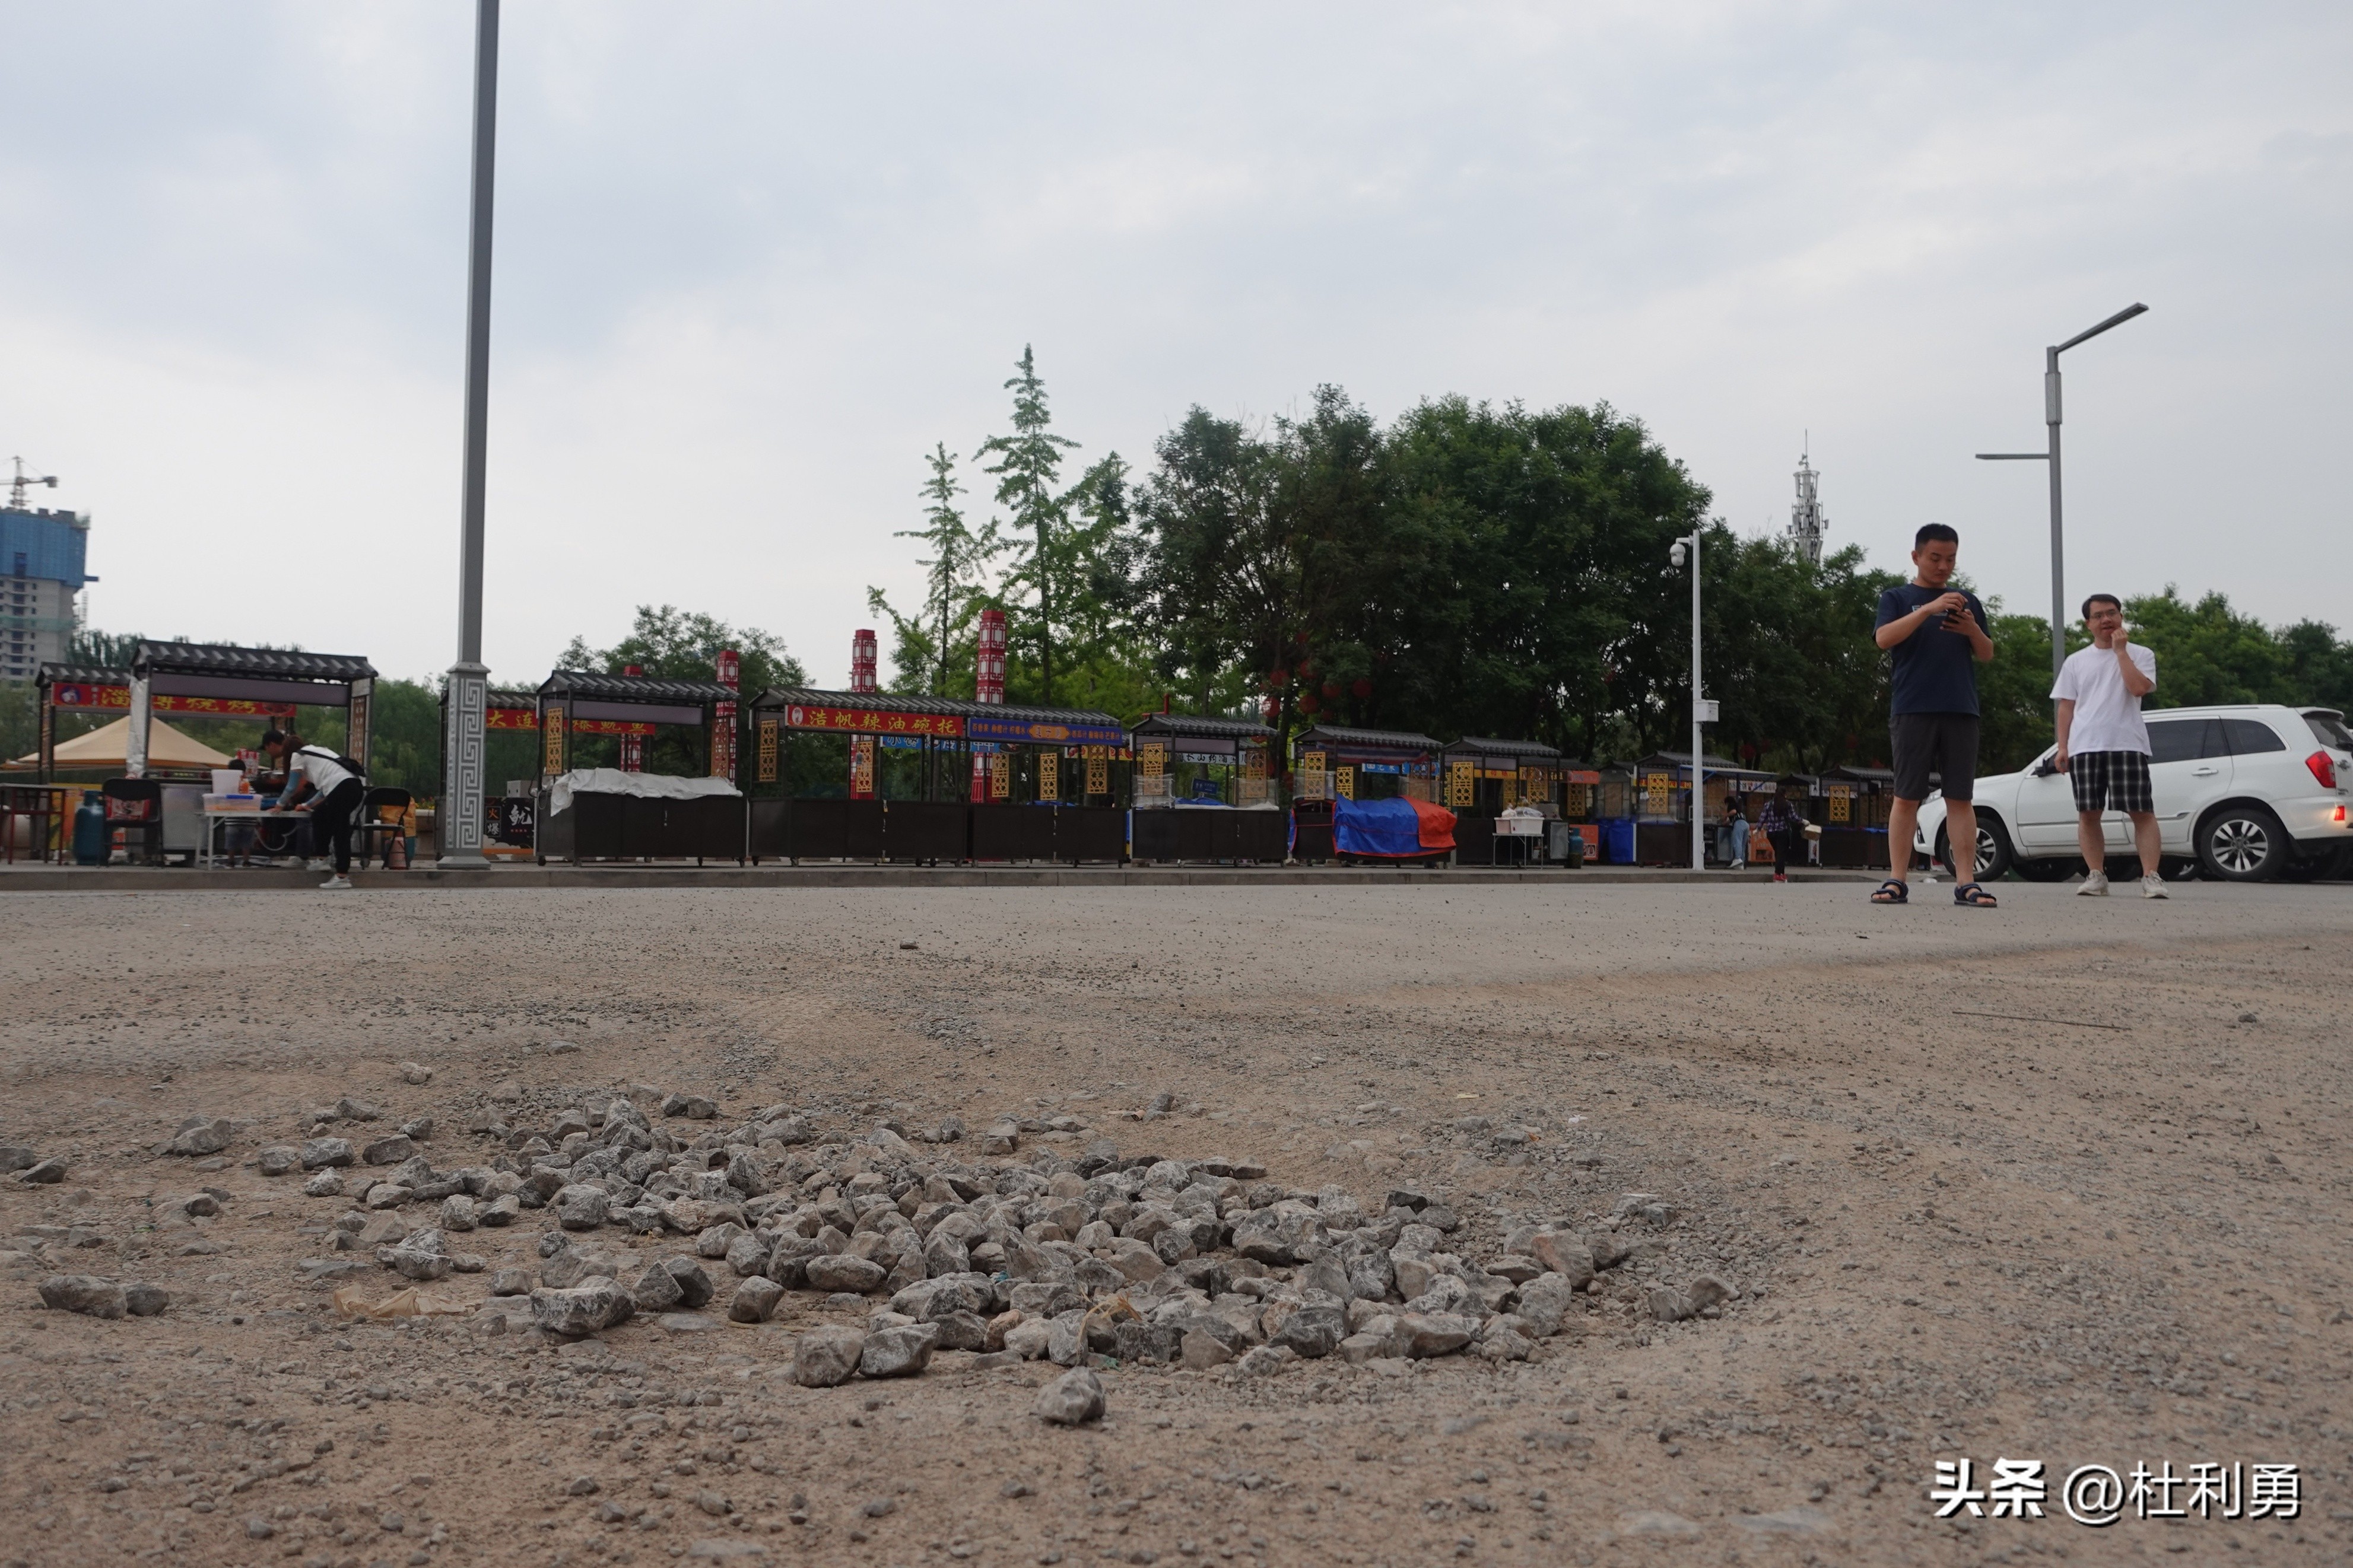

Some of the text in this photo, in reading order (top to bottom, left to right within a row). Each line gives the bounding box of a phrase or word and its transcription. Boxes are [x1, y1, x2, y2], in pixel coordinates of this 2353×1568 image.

[488, 710, 646, 731] 大连爆鱿鱼
[809, 709, 957, 733] 浩帆辣油碗托
